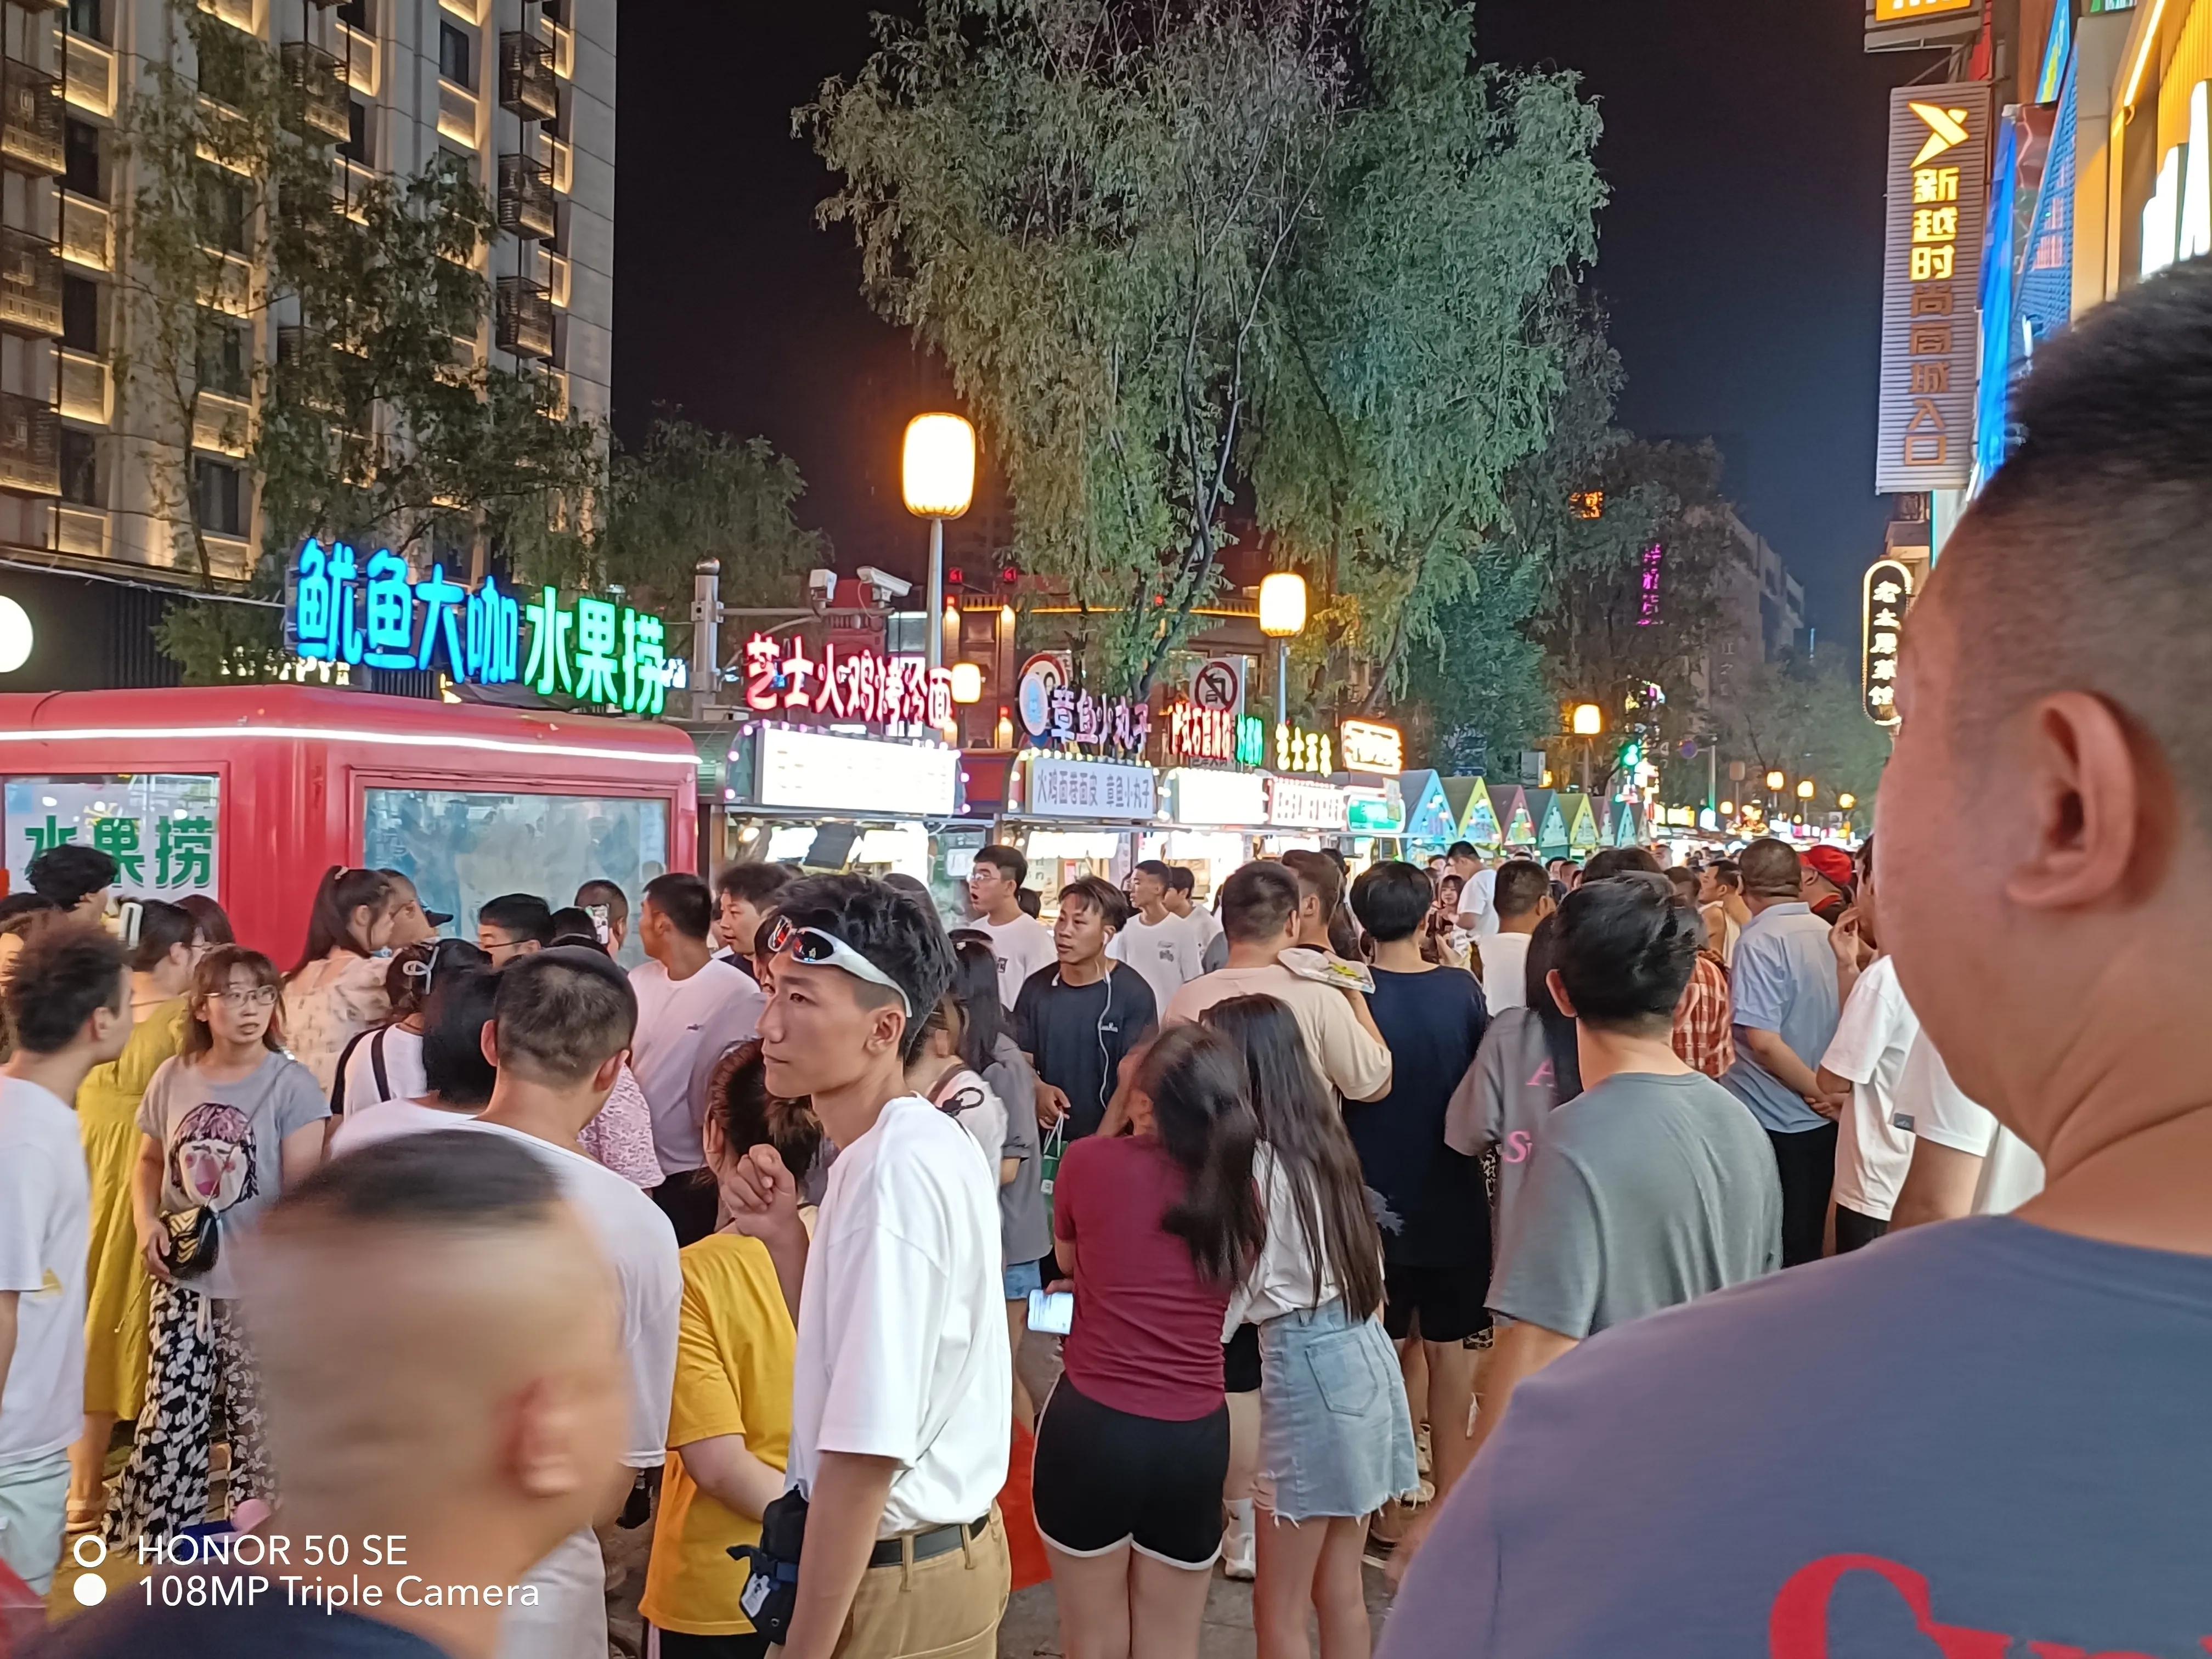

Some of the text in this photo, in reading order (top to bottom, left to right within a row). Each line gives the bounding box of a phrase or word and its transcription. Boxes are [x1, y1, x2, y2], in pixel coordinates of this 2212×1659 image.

[1904, 167, 1960, 467] 新越时尚商城入口
[296, 536, 520, 685] 鱿鱼大咖
[524, 585, 666, 715] 水果捞
[1051, 684, 1152, 750] 章鱼小丸子
[1106, 773, 1150, 809] 章鱼小丸子
